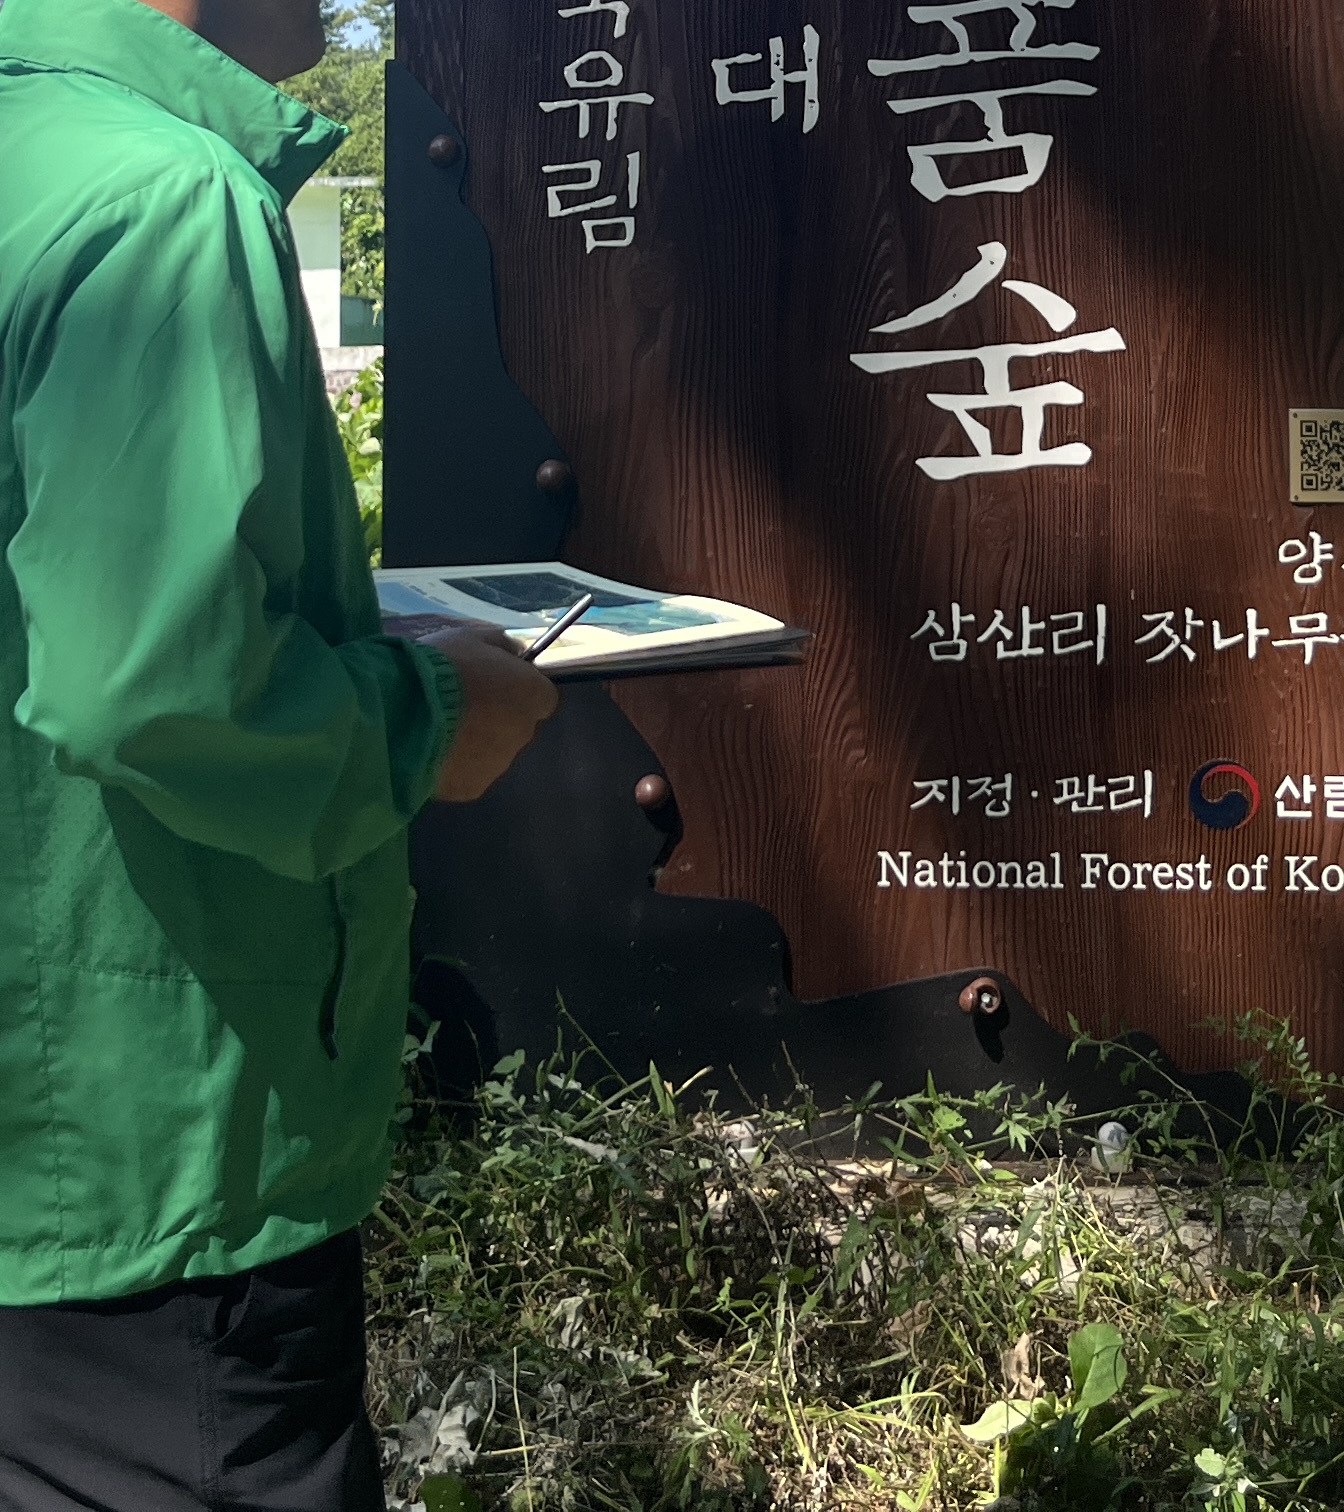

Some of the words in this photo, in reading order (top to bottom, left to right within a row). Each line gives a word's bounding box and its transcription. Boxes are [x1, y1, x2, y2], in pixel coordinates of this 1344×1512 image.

[909, 602, 1107, 666] 삼산리
[876, 850, 1064, 889] National
[1080, 852, 1213, 890] Forest
[1226, 855, 1269, 891] of
